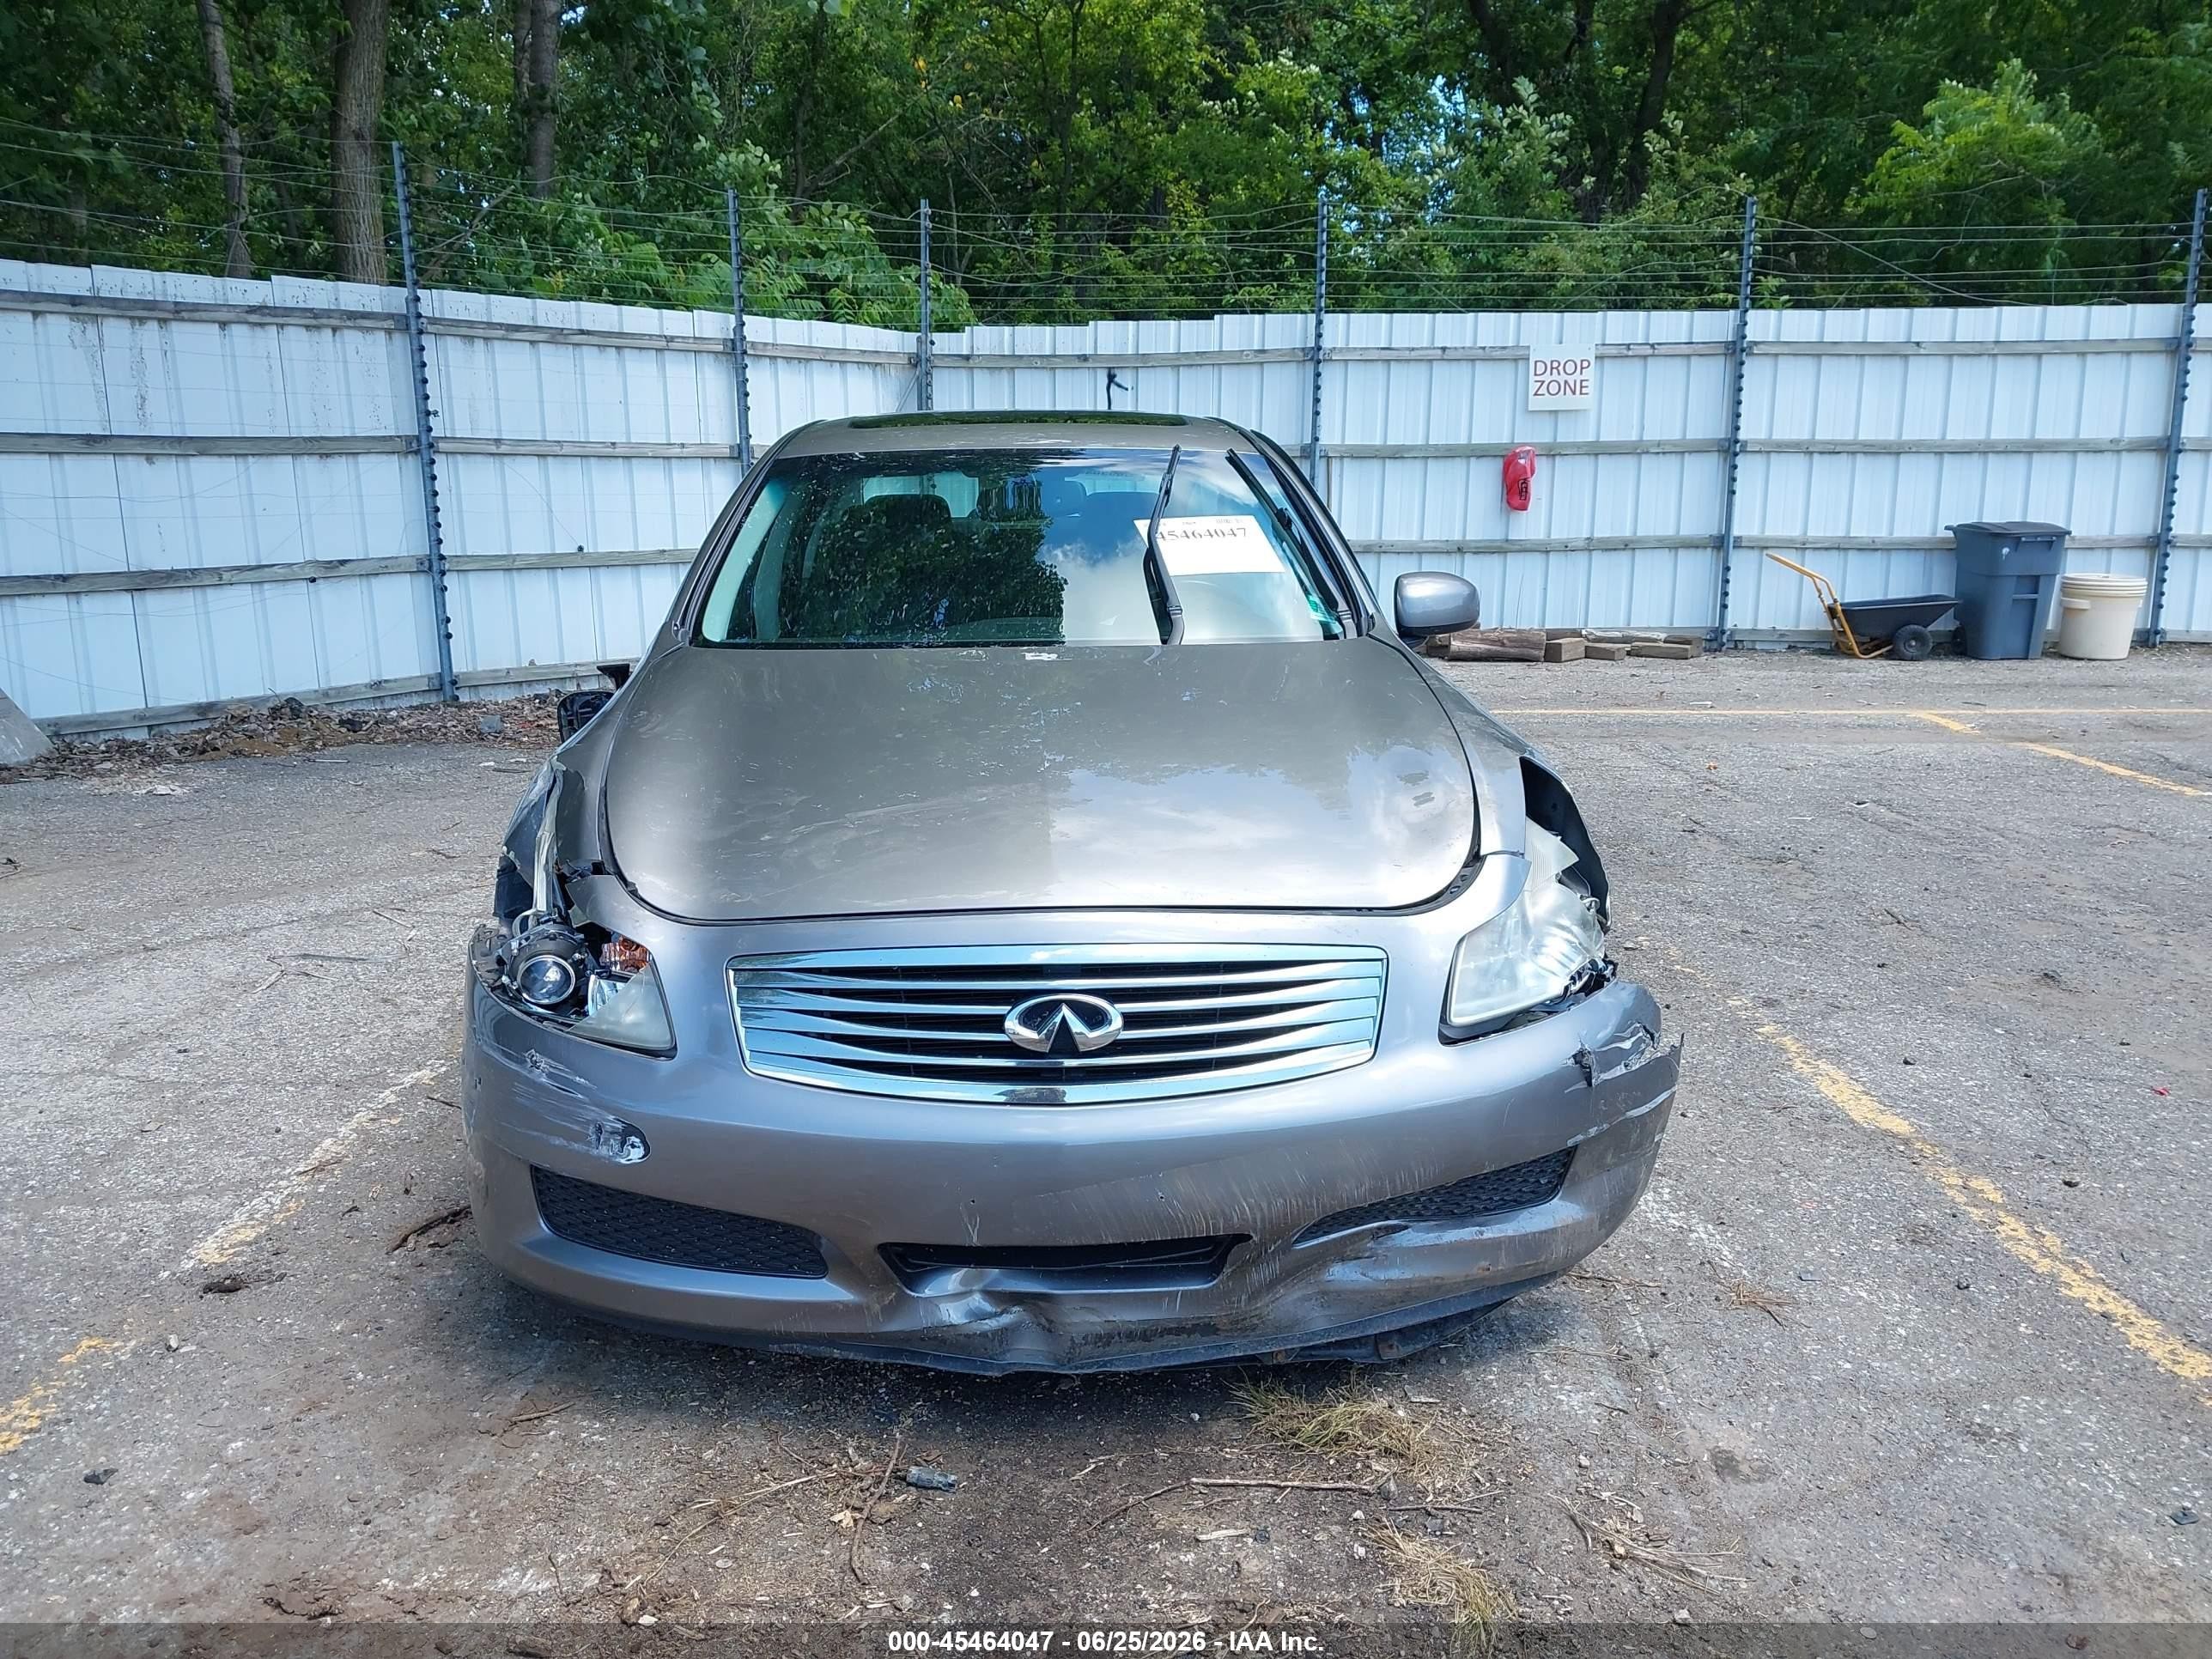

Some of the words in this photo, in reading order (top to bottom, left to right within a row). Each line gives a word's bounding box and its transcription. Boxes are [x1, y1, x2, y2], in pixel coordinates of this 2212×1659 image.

[1533, 359, 1591, 376] DROP
[1533, 379, 1589, 397] ZONE
[1156, 527, 1247, 542] 45464047
